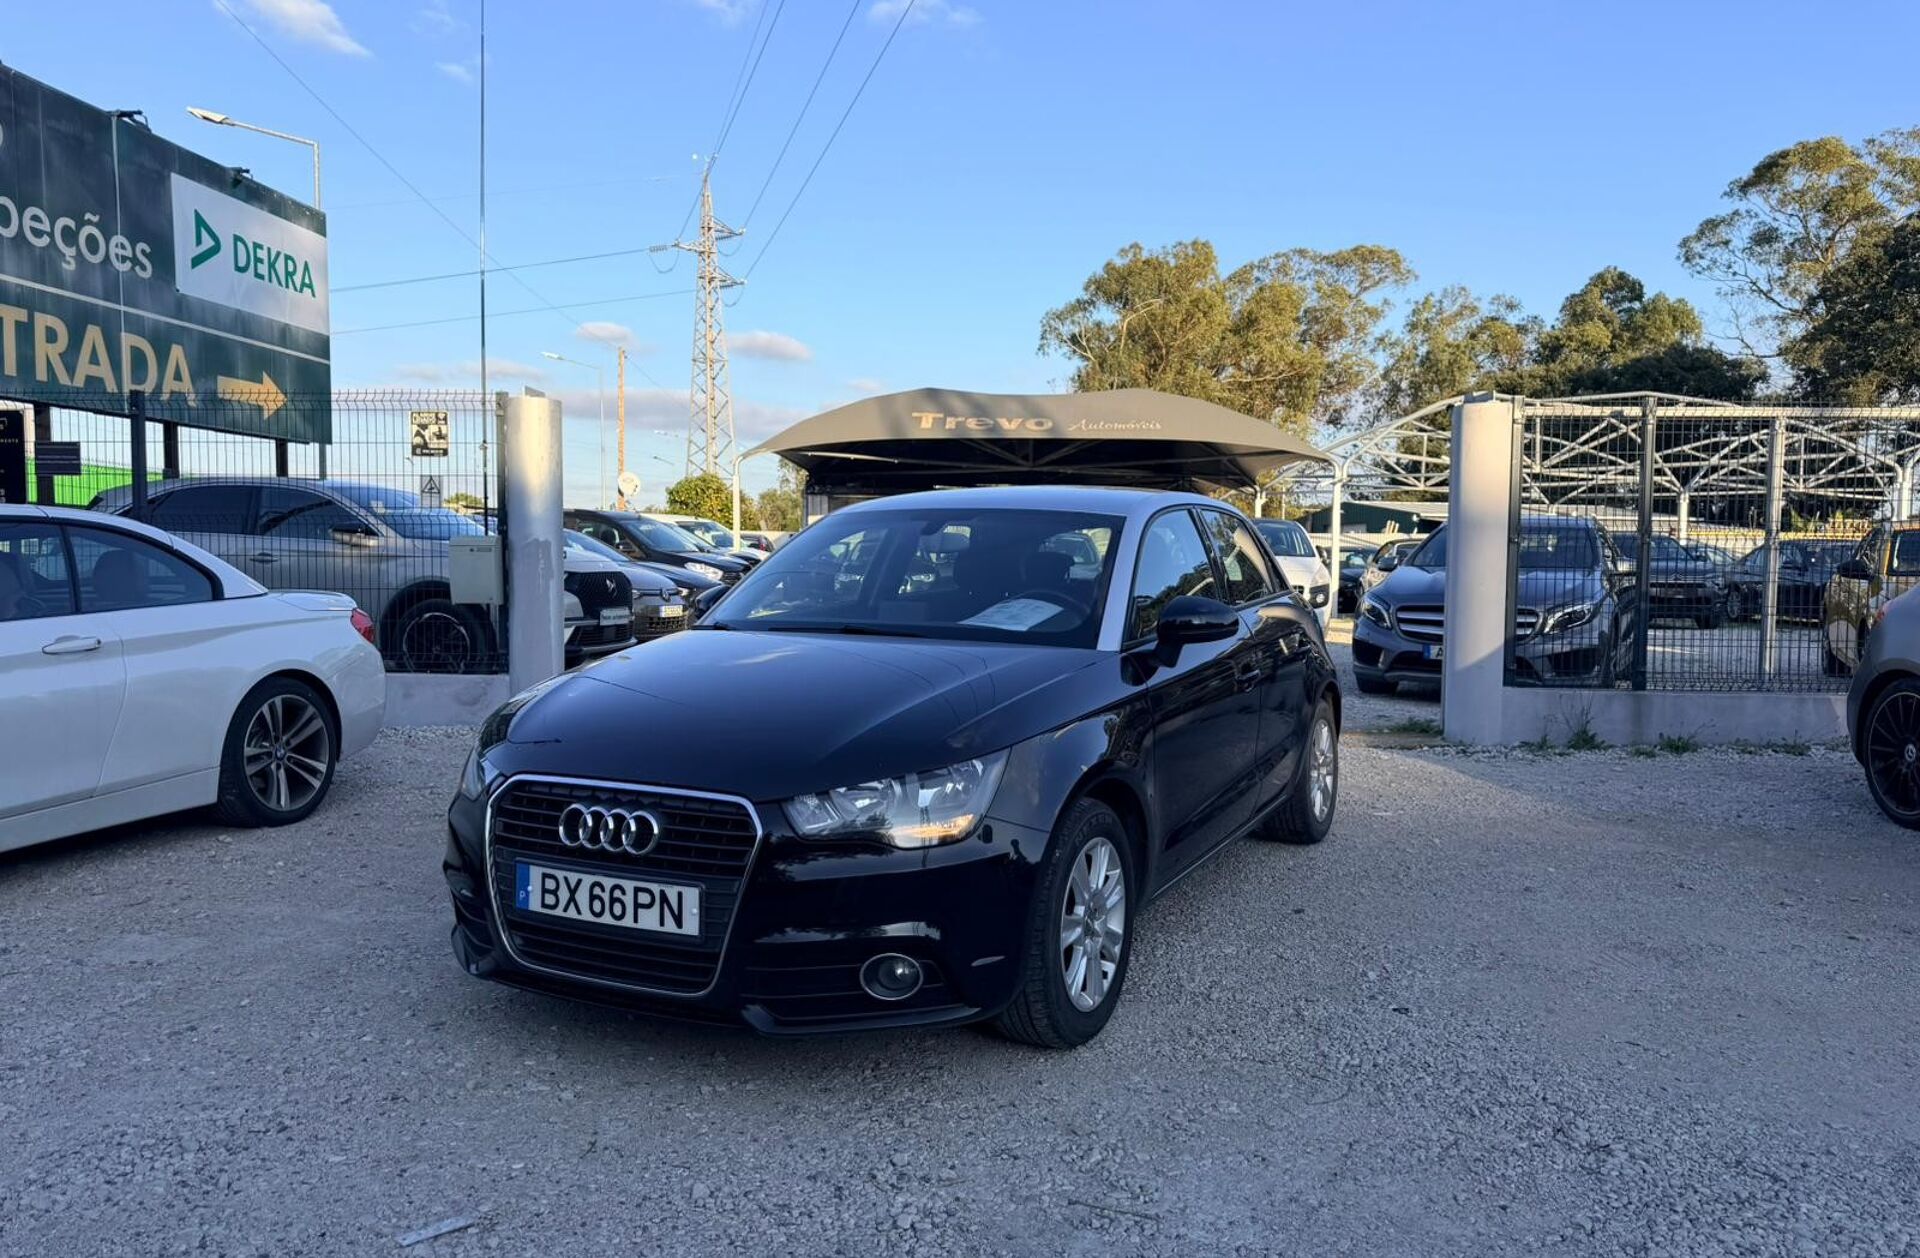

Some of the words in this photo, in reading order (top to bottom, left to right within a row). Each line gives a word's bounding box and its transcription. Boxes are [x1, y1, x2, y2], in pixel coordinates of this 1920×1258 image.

[232, 233, 316, 298] DEKRA
[0, 303, 197, 408] TRADA
[911, 411, 1053, 431] Trevo
